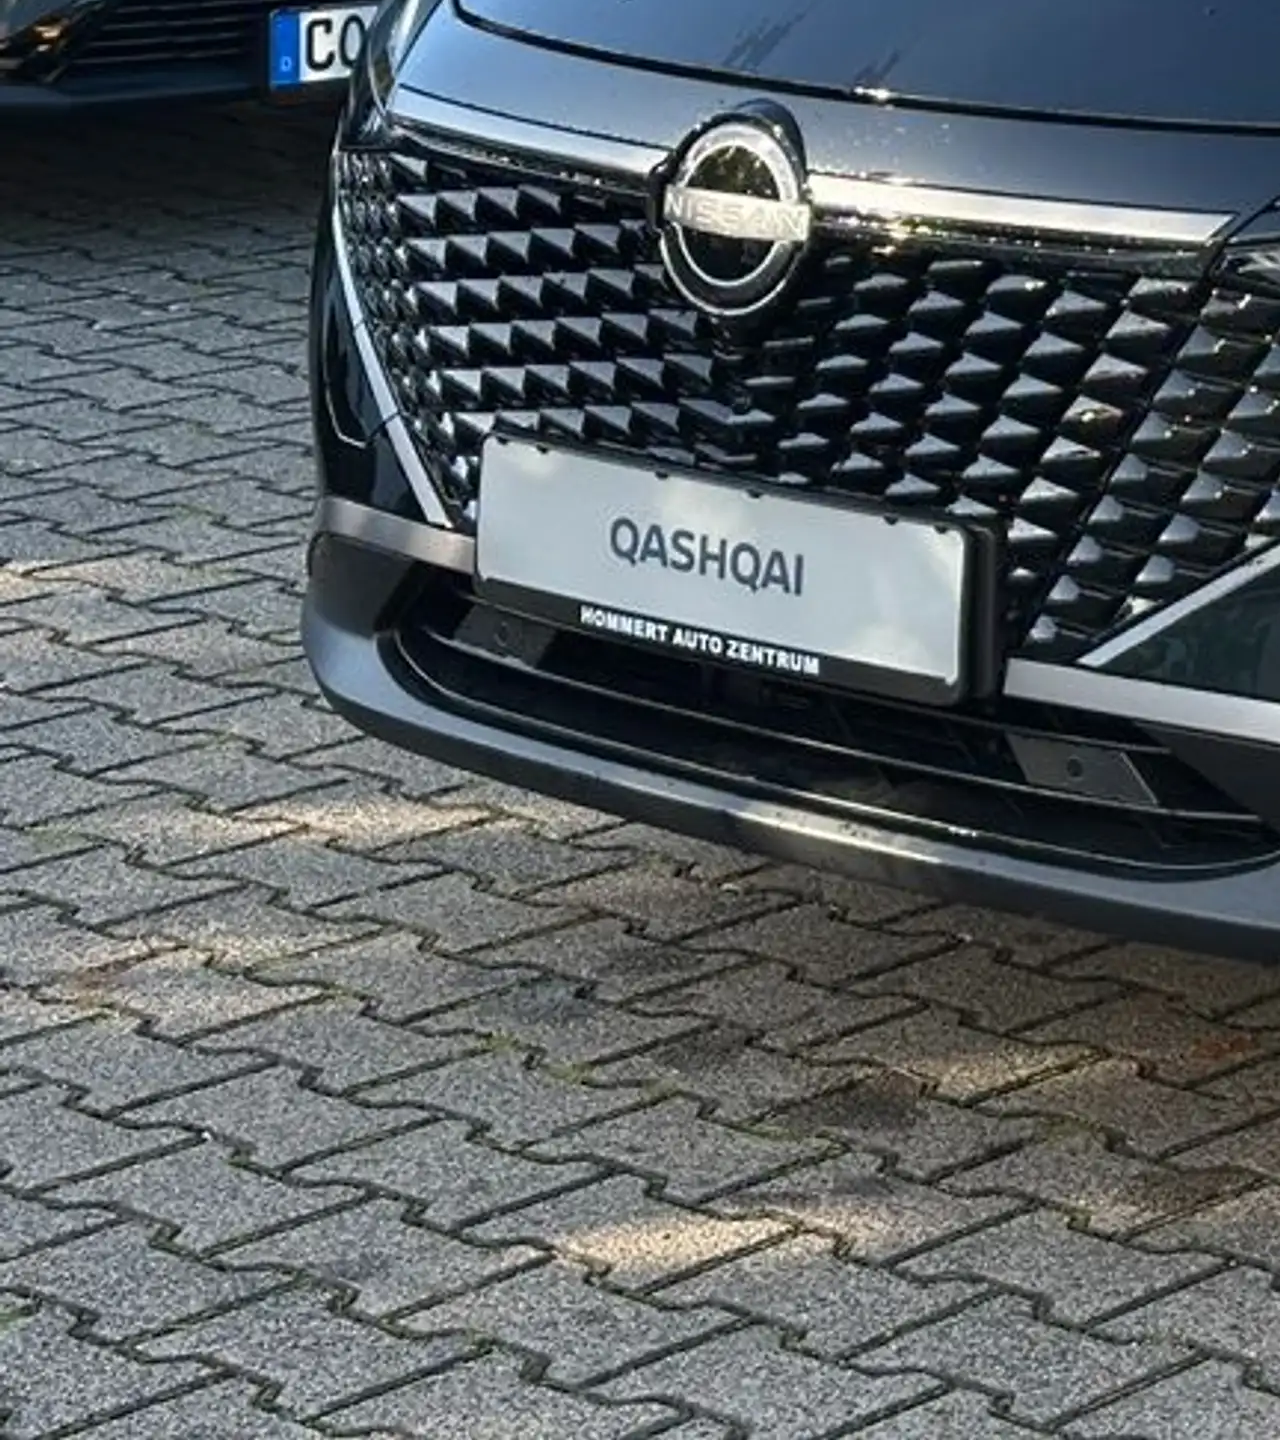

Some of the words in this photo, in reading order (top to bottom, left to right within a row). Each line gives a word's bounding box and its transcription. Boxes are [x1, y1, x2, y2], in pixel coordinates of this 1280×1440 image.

[306, 13, 365, 72] CO
[664, 188, 808, 241] NISSAN
[609, 517, 806, 596] QASHQAI
[580, 604, 669, 643] HOMMERT
[672, 627, 723, 655] AUTO
[725, 639, 821, 676] ZENTRUM
